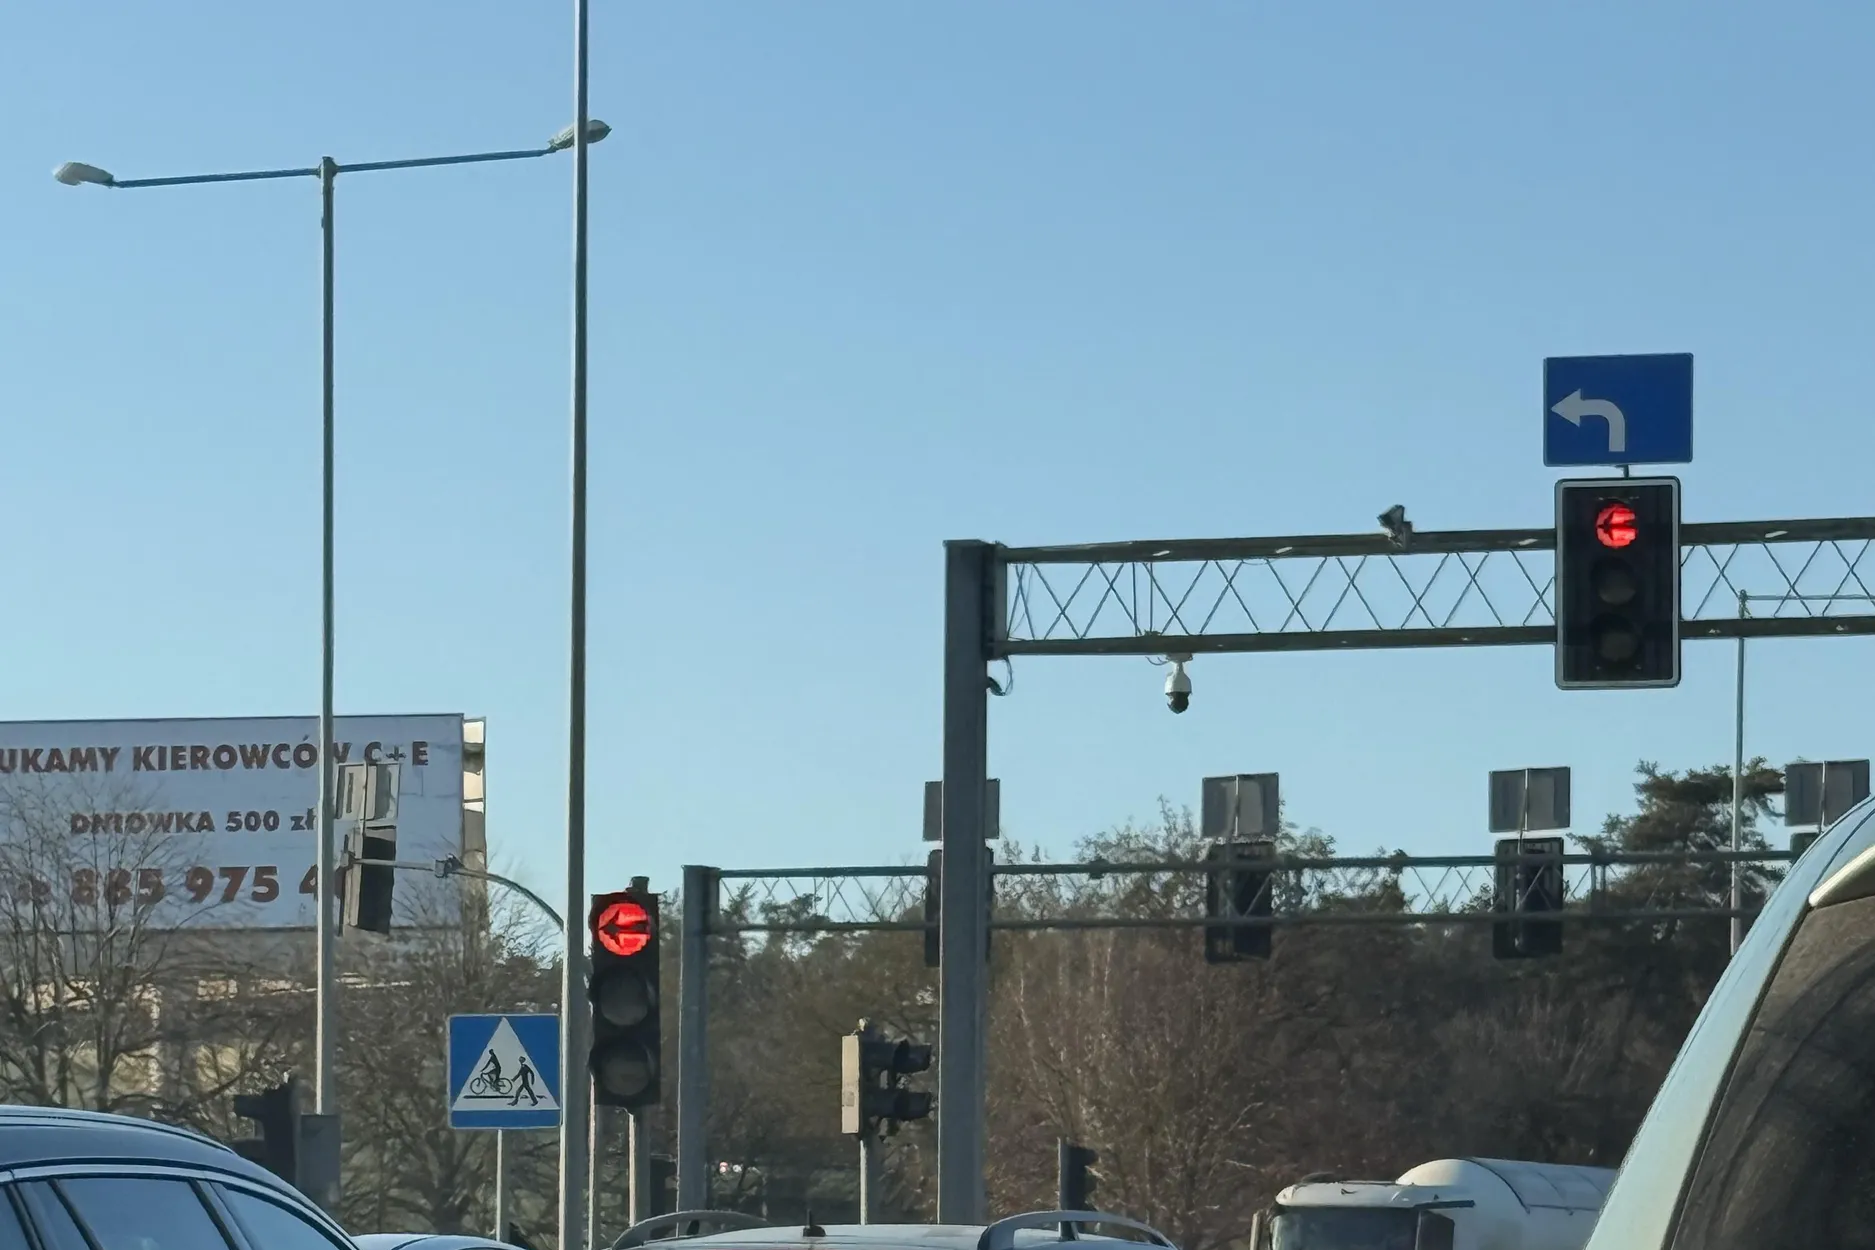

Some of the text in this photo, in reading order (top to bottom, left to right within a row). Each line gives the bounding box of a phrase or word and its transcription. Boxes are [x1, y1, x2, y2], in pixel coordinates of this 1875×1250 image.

[226, 810, 280, 832] 500
[72, 868, 165, 905] 885
[186, 866, 280, 903] 975
